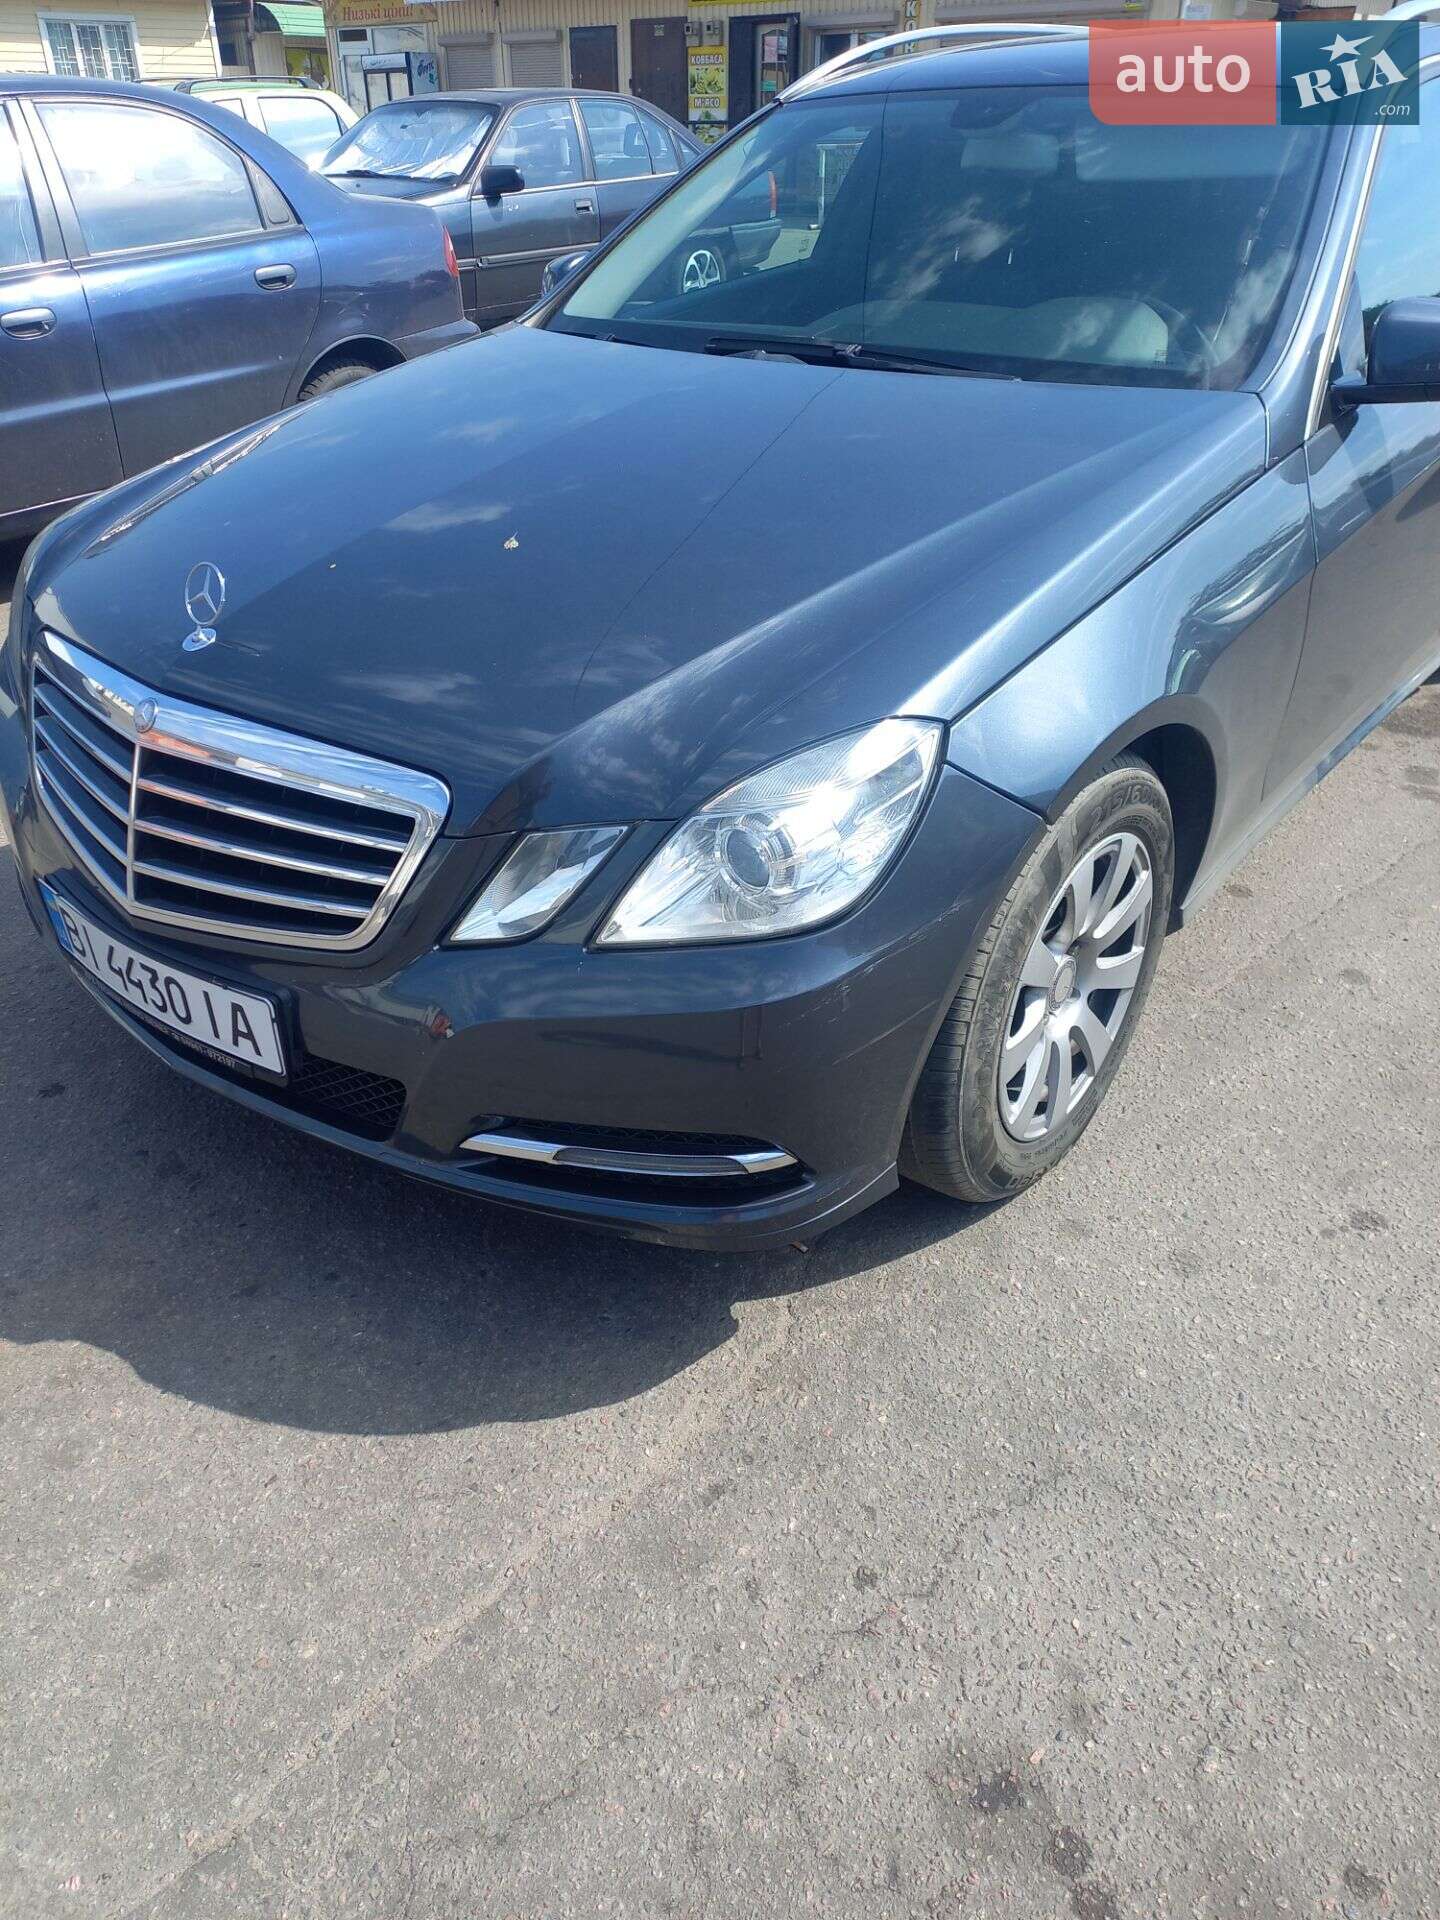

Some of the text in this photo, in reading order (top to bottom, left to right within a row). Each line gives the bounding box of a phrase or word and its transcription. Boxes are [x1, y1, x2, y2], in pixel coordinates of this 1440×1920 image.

[690, 54, 723, 65] КОВБАСА
[58, 906, 100, 971] BI
[106, 944, 193, 1025] 4430
[202, 990, 263, 1057] IA
